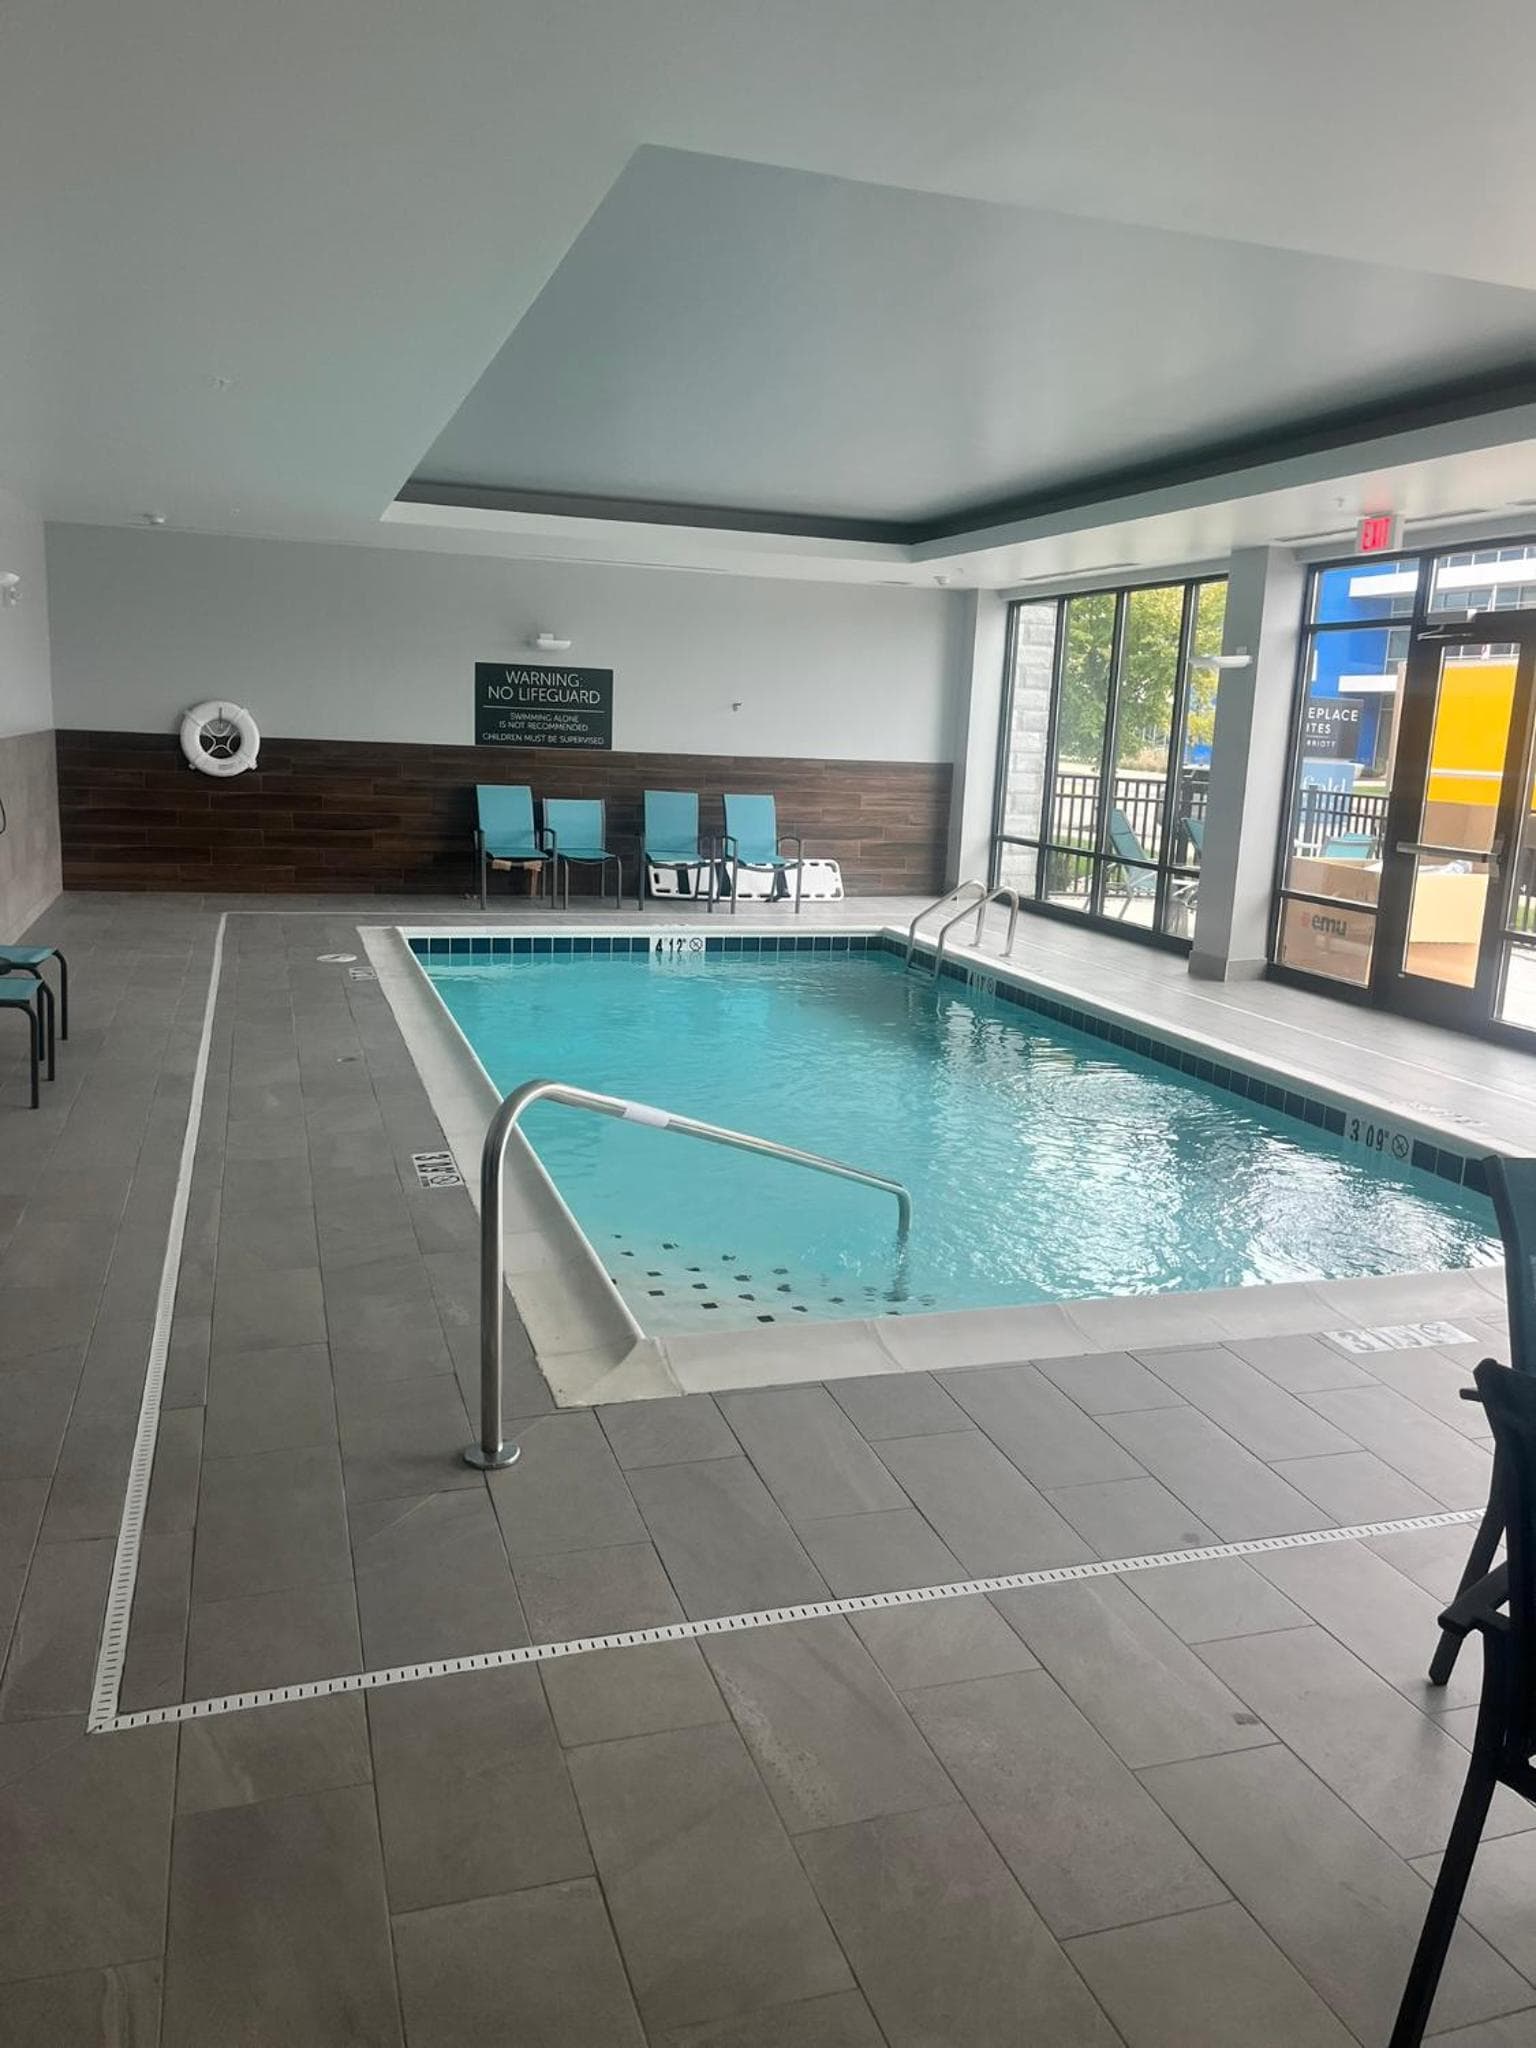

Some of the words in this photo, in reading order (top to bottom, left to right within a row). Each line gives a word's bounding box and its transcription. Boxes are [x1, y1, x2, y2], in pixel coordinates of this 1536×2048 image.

[488, 685, 514, 700] NO
[518, 687, 601, 704] LIFEGUARD
[510, 712, 552, 722] SWIMMING
[554, 714, 579, 723] ALONE
[1308, 707, 1359, 721] EPLACE
[499, 720, 506, 729] IS
[507, 721, 525, 729] NOT
[528, 722, 589, 732] RECOMMENDED
[482, 732, 522, 741] CHILDREN
[524, 734, 546, 742] MUST
[547, 734, 557, 743] BE
[559, 735, 605, 745] SUPERVISED
[1312, 914, 1347, 936] emu
